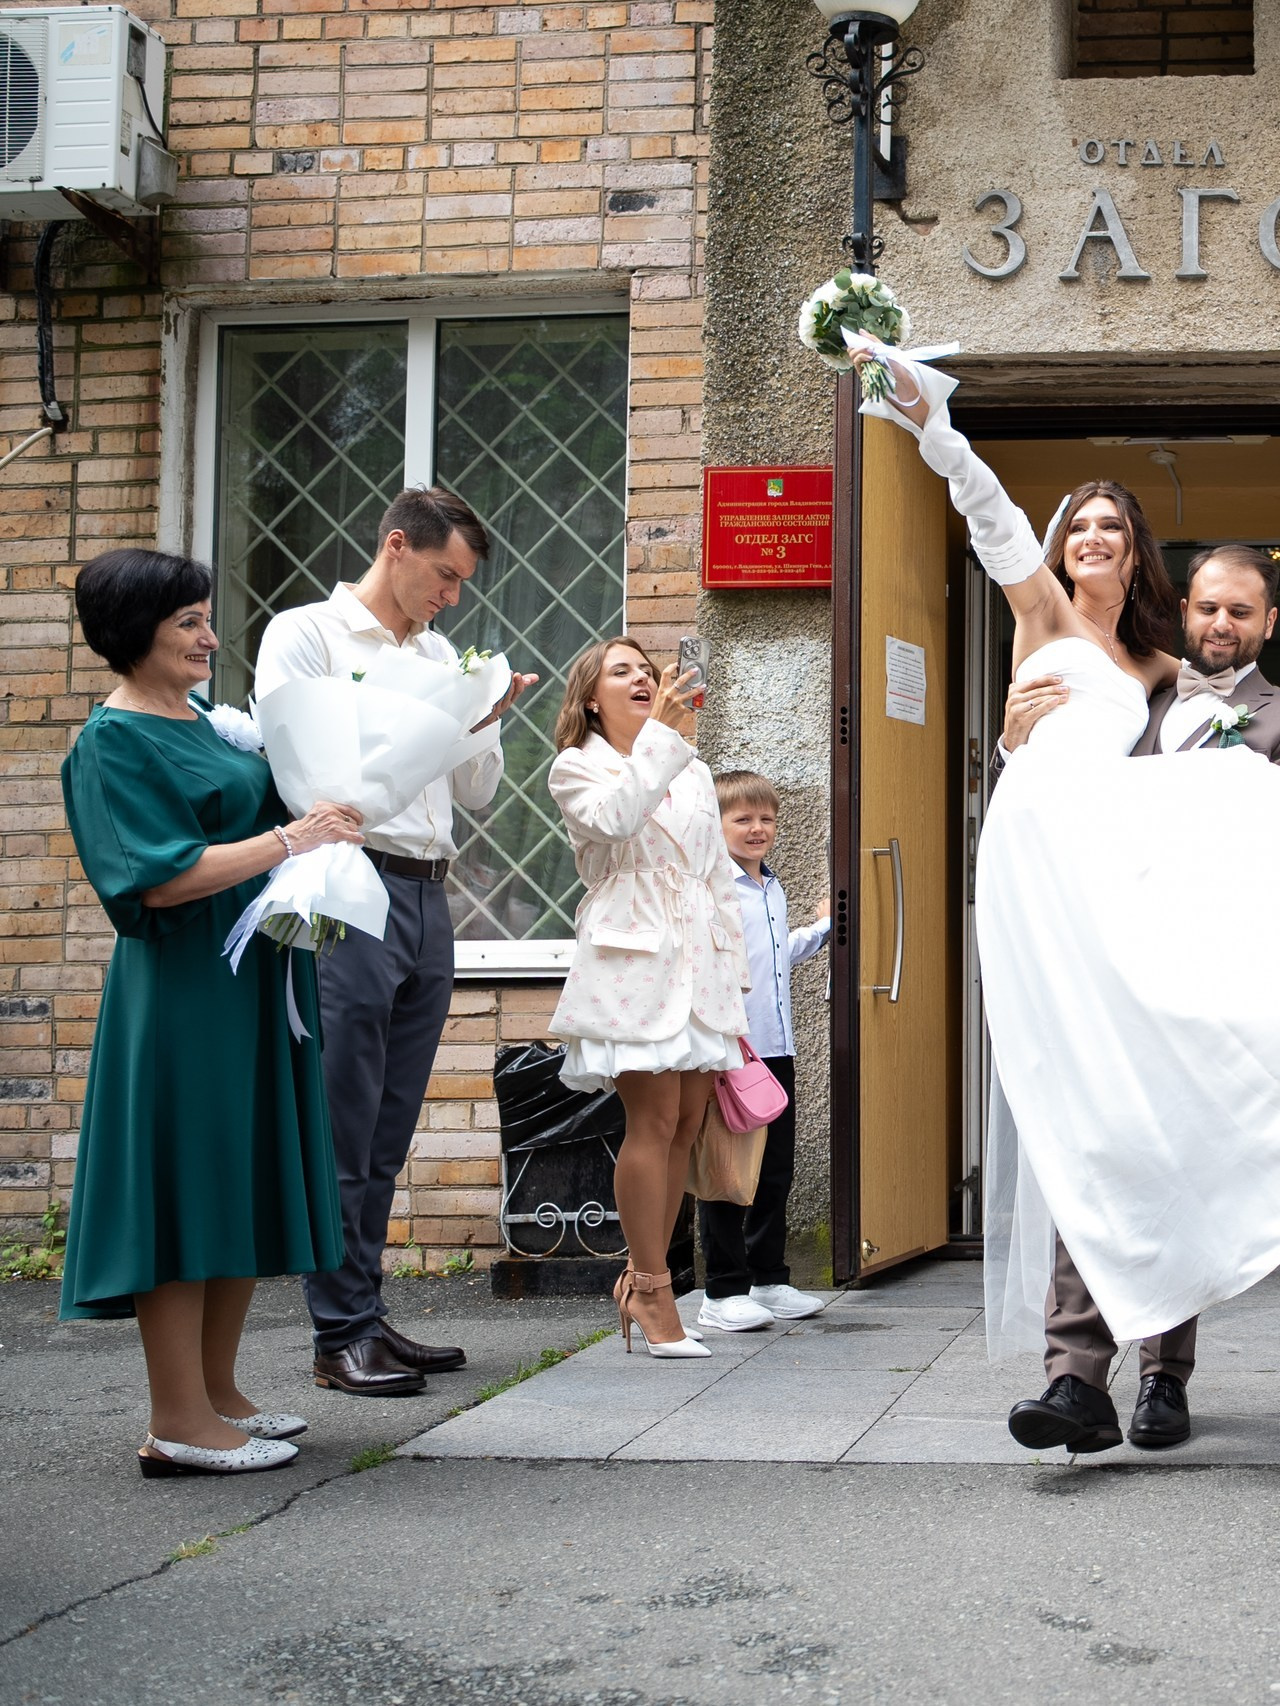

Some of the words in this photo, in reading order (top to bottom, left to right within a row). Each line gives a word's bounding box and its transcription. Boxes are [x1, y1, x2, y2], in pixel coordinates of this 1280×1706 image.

[1078, 138, 1226, 166] ОТДЕЛ
[734, 534, 778, 545] ОТДЕЛ
[781, 534, 814, 544] ЗАГС
[761, 548, 774, 556] №
[776, 546, 786, 559] 3
